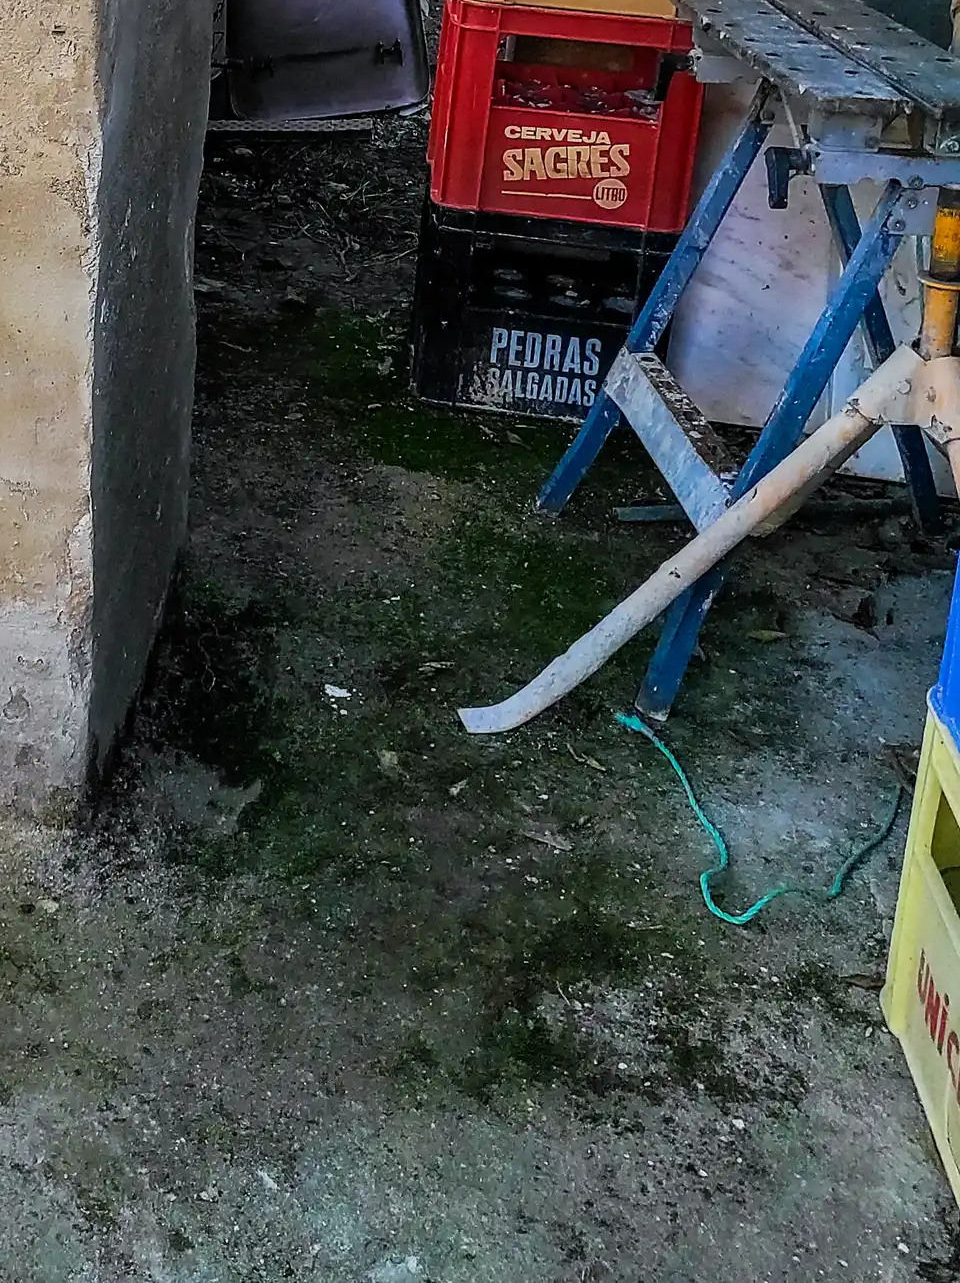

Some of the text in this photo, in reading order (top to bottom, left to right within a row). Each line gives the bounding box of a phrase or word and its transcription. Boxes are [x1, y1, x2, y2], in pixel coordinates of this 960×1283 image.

[503, 125, 611, 145] CERVEJA
[502, 144, 631, 181] SAGRES
[595, 186, 626, 202] LITRO
[489, 327, 602, 376] PEDRAS
[486, 367, 597, 407] SALGADAS
